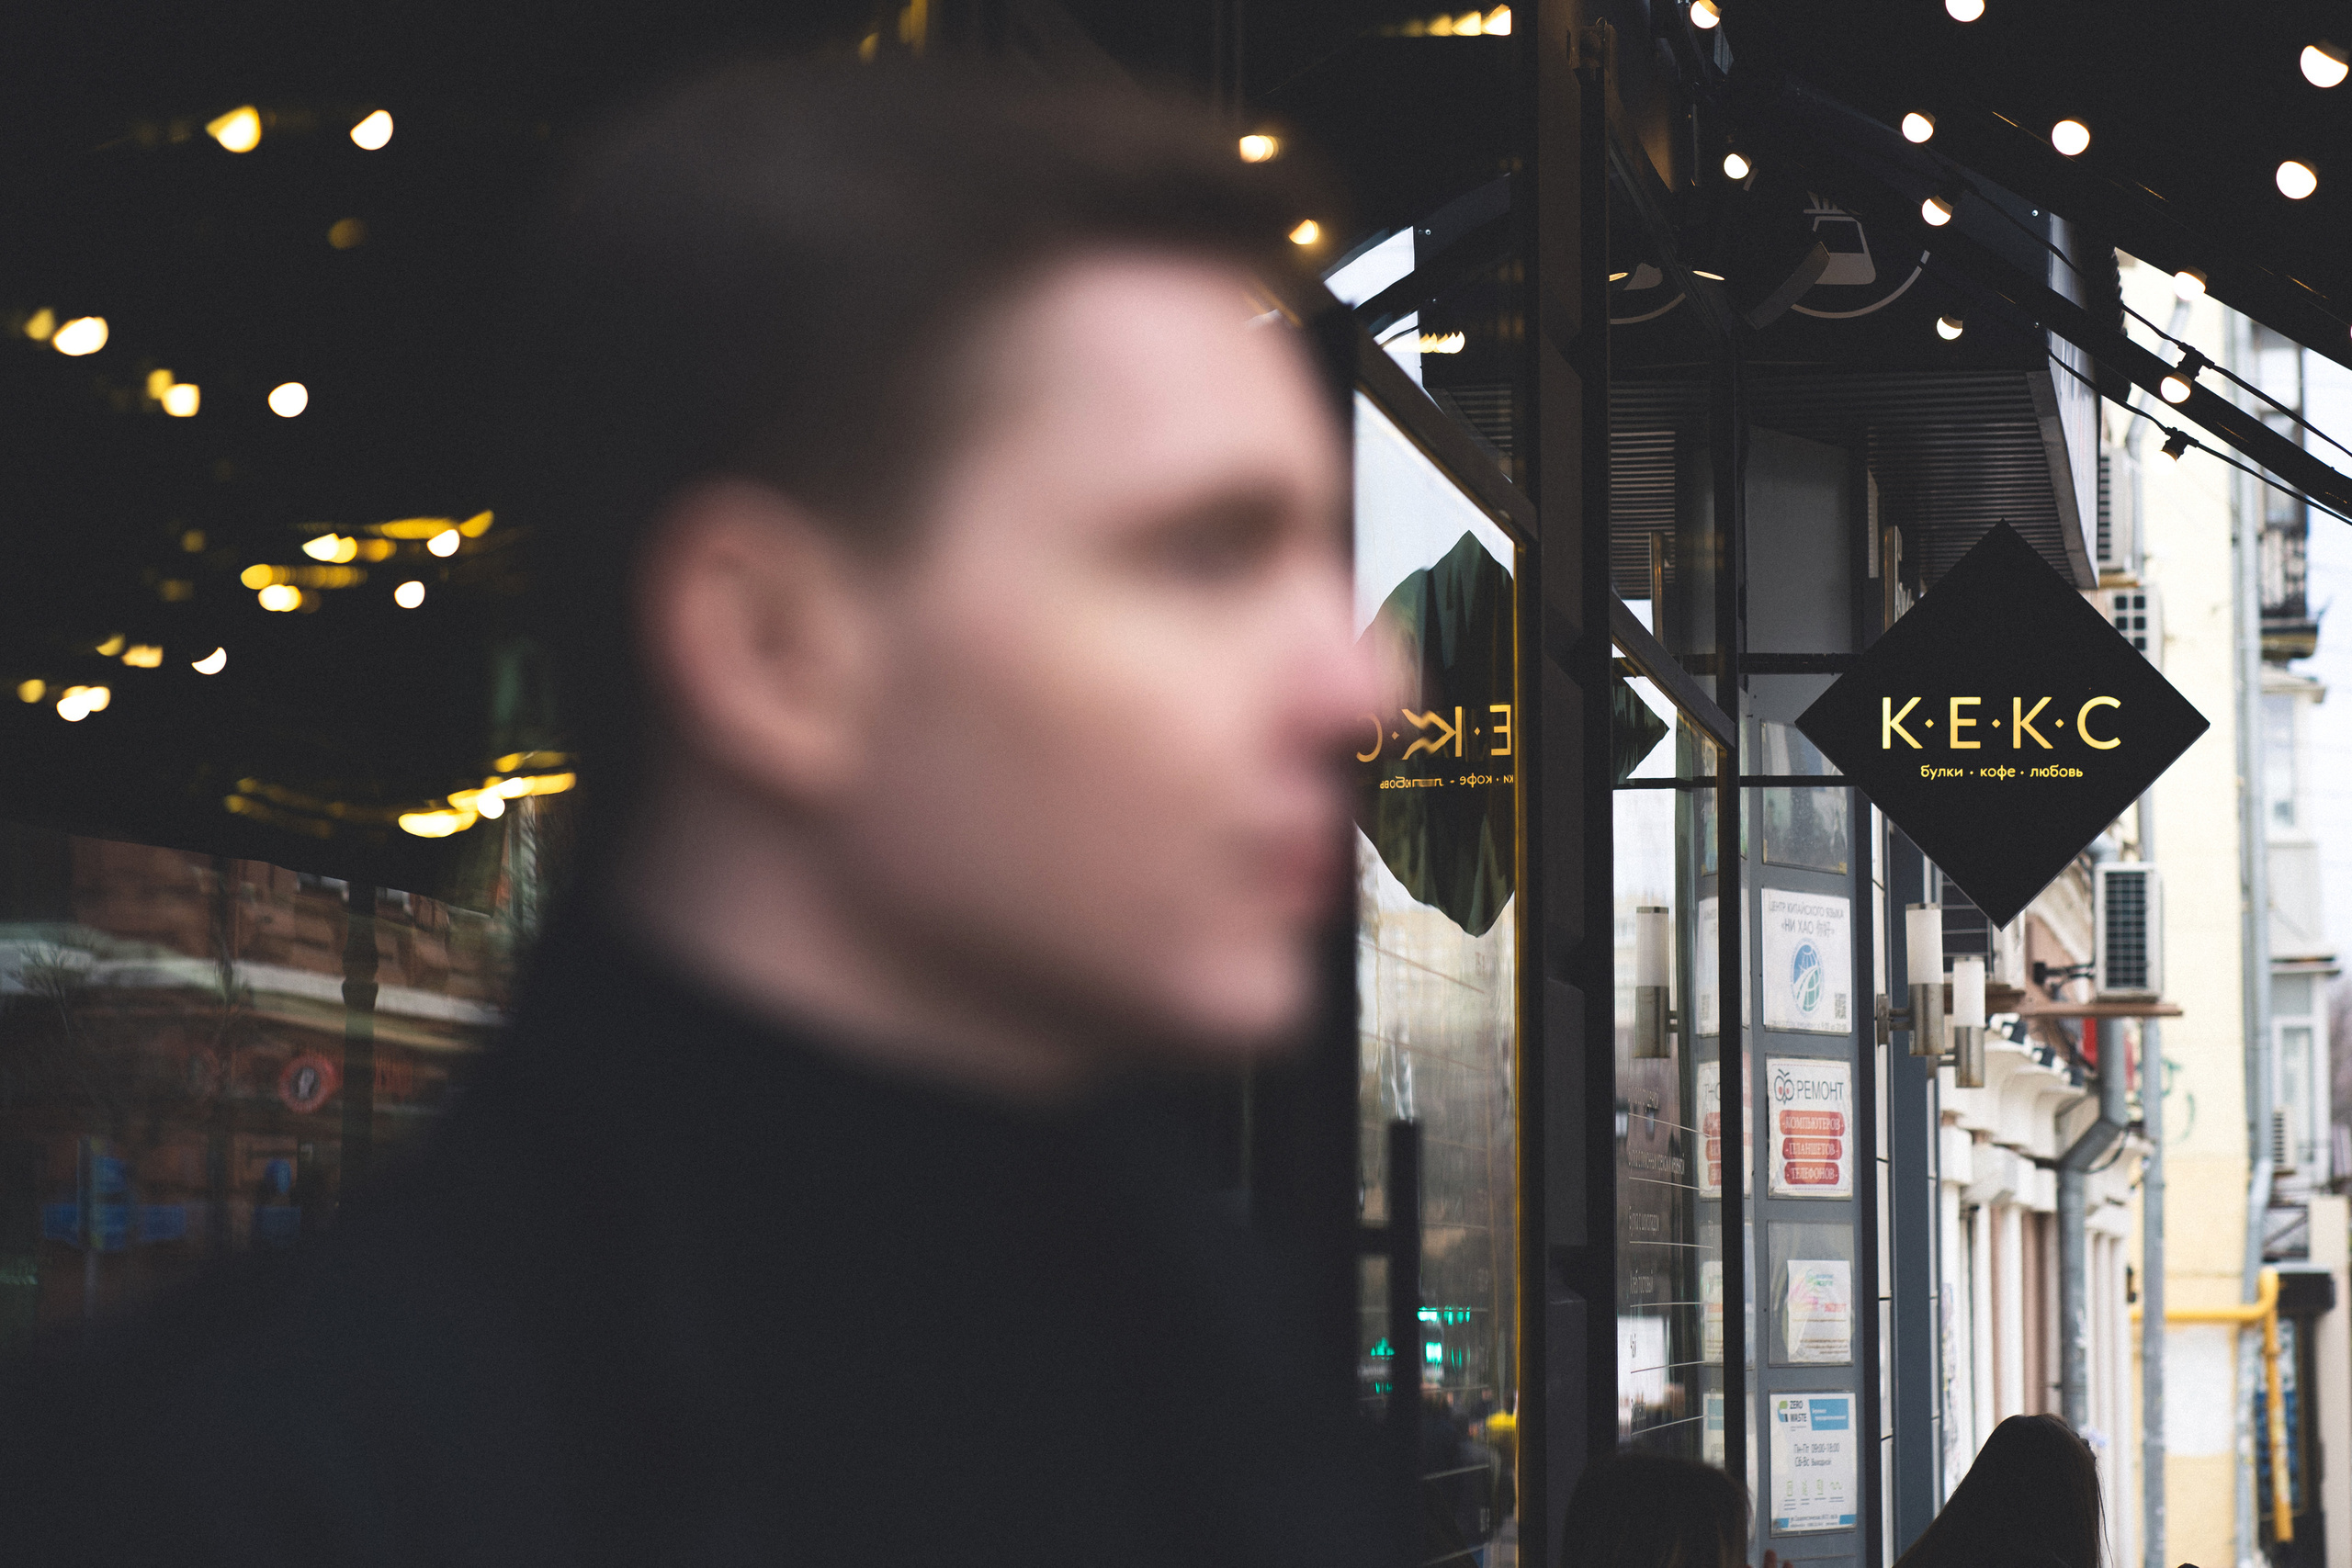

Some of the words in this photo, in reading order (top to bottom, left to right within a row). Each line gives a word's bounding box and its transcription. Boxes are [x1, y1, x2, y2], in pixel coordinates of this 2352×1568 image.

[1920, 764, 1963, 781] булки
[1980, 764, 2016, 781] кофе
[2030, 764, 2084, 778] любовь
[1798, 919, 1814, 935] ХАО
[1797, 1080, 1844, 1100] РЕМОНТ
[1784, 1115, 1841, 1131] КОМПЬЮТЕРОВ
[1789, 1142, 1836, 1156] ПЛАНШЕТОВ
[1791, 1166, 1835, 1180] ТЕЛЕФОНОВ
[1790, 1400, 1804, 1410] ZERO
[1790, 1413, 1807, 1423] WASTE
